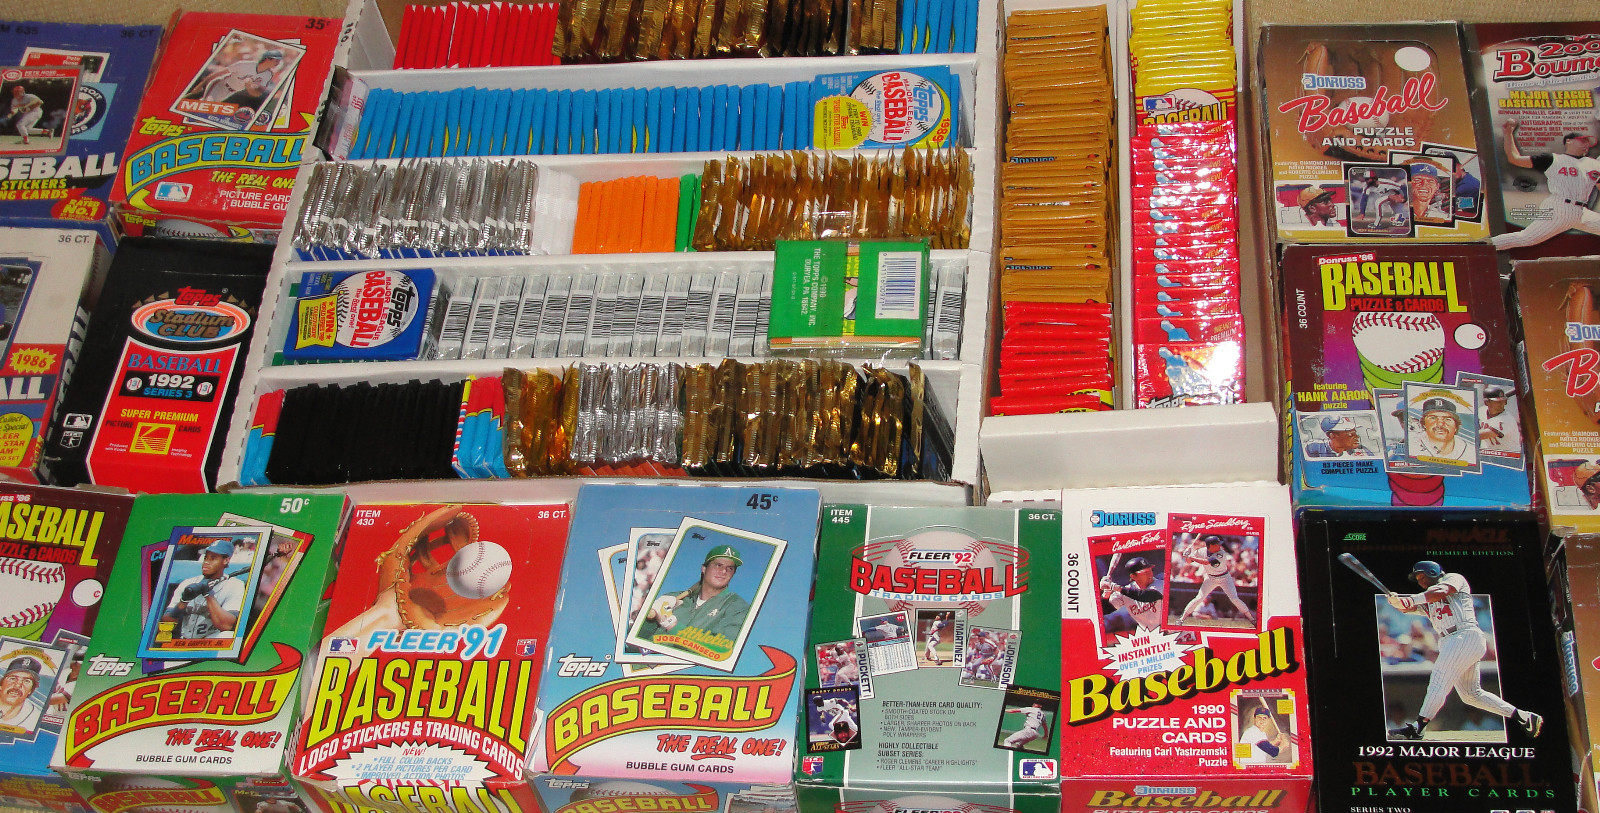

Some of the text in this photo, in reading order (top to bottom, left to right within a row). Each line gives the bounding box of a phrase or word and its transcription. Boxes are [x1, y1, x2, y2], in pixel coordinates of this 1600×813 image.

[1509, 90, 1592, 100] MAJOR LEAGUE
[181, 101, 235, 114] METS
[882, 72, 907, 141] BASEBALL
[903, 79, 914, 135] MAJOR LEAGUE
[1279, 72, 1448, 133] Baseball
[1498, 99, 1594, 108] BASEBALL CARDS
[860, 111, 869, 127] WIN
[932, 118, 950, 143] 1989
[1353, 127, 1414, 137] PUZZLE
[1321, 137, 1416, 147] AND CARDS
[131, 136, 305, 187] BASEBALL
[211, 171, 268, 186] THE REAL
[1558, 166, 1578, 177] 48
[1, 178, 67, 190] STICKERS
[22, 189, 68, 199] CARDS
[220, 190, 262, 201] PICTURE
[69, 199, 100, 208] RATED
[230, 200, 270, 210] BUBBLE
[58, 235, 90, 243] 36 CT.
[813, 248, 821, 281] THE TOPPS
[1318, 254, 1374, 265] Donruss '86
[1320, 261, 1467, 313] BASEBALL
[350, 270, 386, 347] BASEBALL
[1296, 289, 1308, 329] 36 COUNT
[1351, 298, 1446, 312] PUZZLE CARDS
[151, 309, 235, 327] Stadium
[326, 307, 336, 333] WIN
[371, 307, 389, 340] LEAGUE
[158, 324, 221, 338] CLUB
[16, 353, 48, 368] 1986
[127, 354, 222, 373] BASEBALL
[149, 374, 195, 389] 1992
[1314, 382, 1347, 391] featuring
[143, 388, 183, 398] SERIES
[1298, 390, 1370, 402] HANK AARON
[1323, 402, 1348, 410] puzzle
[121, 408, 199, 422] SUPER PREMIUM
[4, 423, 28, 432] Special
[105, 421, 134, 429] PICTURE
[178, 425, 202, 433] CARDS
[356, 509, 381, 518] ITEM
[537, 510, 566, 519] 36 CT.
[831, 509, 853, 517] ITEM
[831, 516, 850, 524] 445
[1090, 510, 1156, 528] DONRUSS
[356, 518, 374, 526] 430
[37, 547, 78, 564] CARDS
[908, 552, 951, 561] FLEER
[850, 556, 1029, 598] BASEBALL
[1066, 553, 1080, 613] 36 COUNT
[873, 590, 1004, 601] TRADING CARDS
[1437, 606, 1453, 620] 34
[367, 631, 460, 651] FLEER
[677, 626, 734, 649] Athletics
[954, 623, 963, 663] MARTINEZ
[1131, 636, 1150, 648] WIN
[656, 635, 721, 661] JOSE CANSECO
[1118, 642, 1171, 662] INSTANTLY!
[1000, 645, 1016, 686] JOHNSON
[1120, 661, 1139, 671] OVER
[1146, 651, 1175, 665] MILLION
[858, 651, 871, 694] PUCKETT
[1068, 626, 1291, 724] Baseball
[1138, 663, 1163, 674] PRIZES
[306, 658, 533, 754] BASEBALL
[1191, 704, 1225, 714] 1990
[73, 679, 278, 749] BASEBALL
[555, 684, 773, 752] BASEBALL
[1113, 717, 1226, 729] PUZZLE AND
[165, 728, 281, 752] THE REAL ONE!
[1162, 732, 1227, 744] CARDS
[299, 738, 339, 776] LOGO
[342, 721, 409, 749] STICKERS
[413, 721, 423, 736] &
[426, 721, 481, 748] TRADING
[483, 735, 525, 781] CARDS
[402, 747, 427, 756] NEW!
[657, 734, 786, 760] THE REAL ONE!
[1110, 746, 1227, 757] Featuring Carl Yastrzemski
[1358, 746, 1535, 760] 1992 MAJOR LEAGUE
[136, 755, 232, 765] BUBBLE GUM CARDS
[378, 757, 453, 765] FULL COLOR BACKS
[1199, 757, 1228, 767] Puzzle
[364, 764, 393, 772] PLAYER
[396, 764, 432, 773] PICTURES
[434, 765, 449, 773] PER
[626, 762, 734, 774] BUBBLE GUM CARDS
[1086, 789, 1287, 809] Baseball
[1351, 788, 1555, 798] PLAYER CARDS
